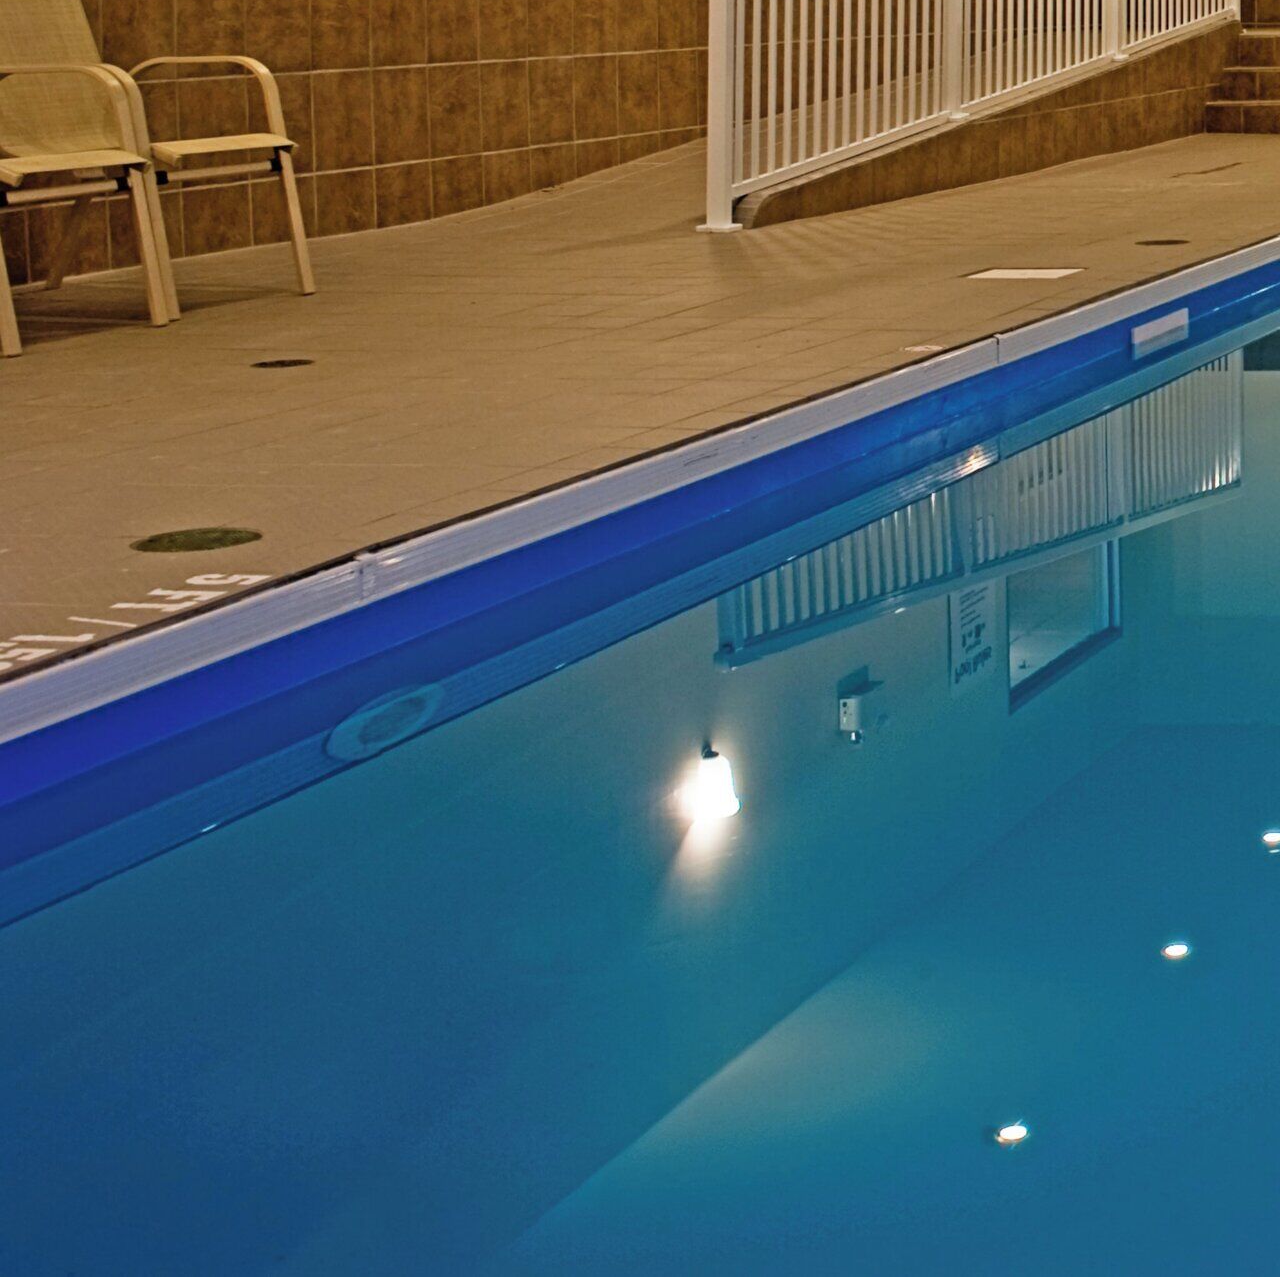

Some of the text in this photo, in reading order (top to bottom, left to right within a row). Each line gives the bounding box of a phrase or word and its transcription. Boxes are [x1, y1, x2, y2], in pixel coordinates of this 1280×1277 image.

[185, 573, 273, 586] 5
[109, 588, 228, 613] FT
[0, 633, 96, 671] 1.5
